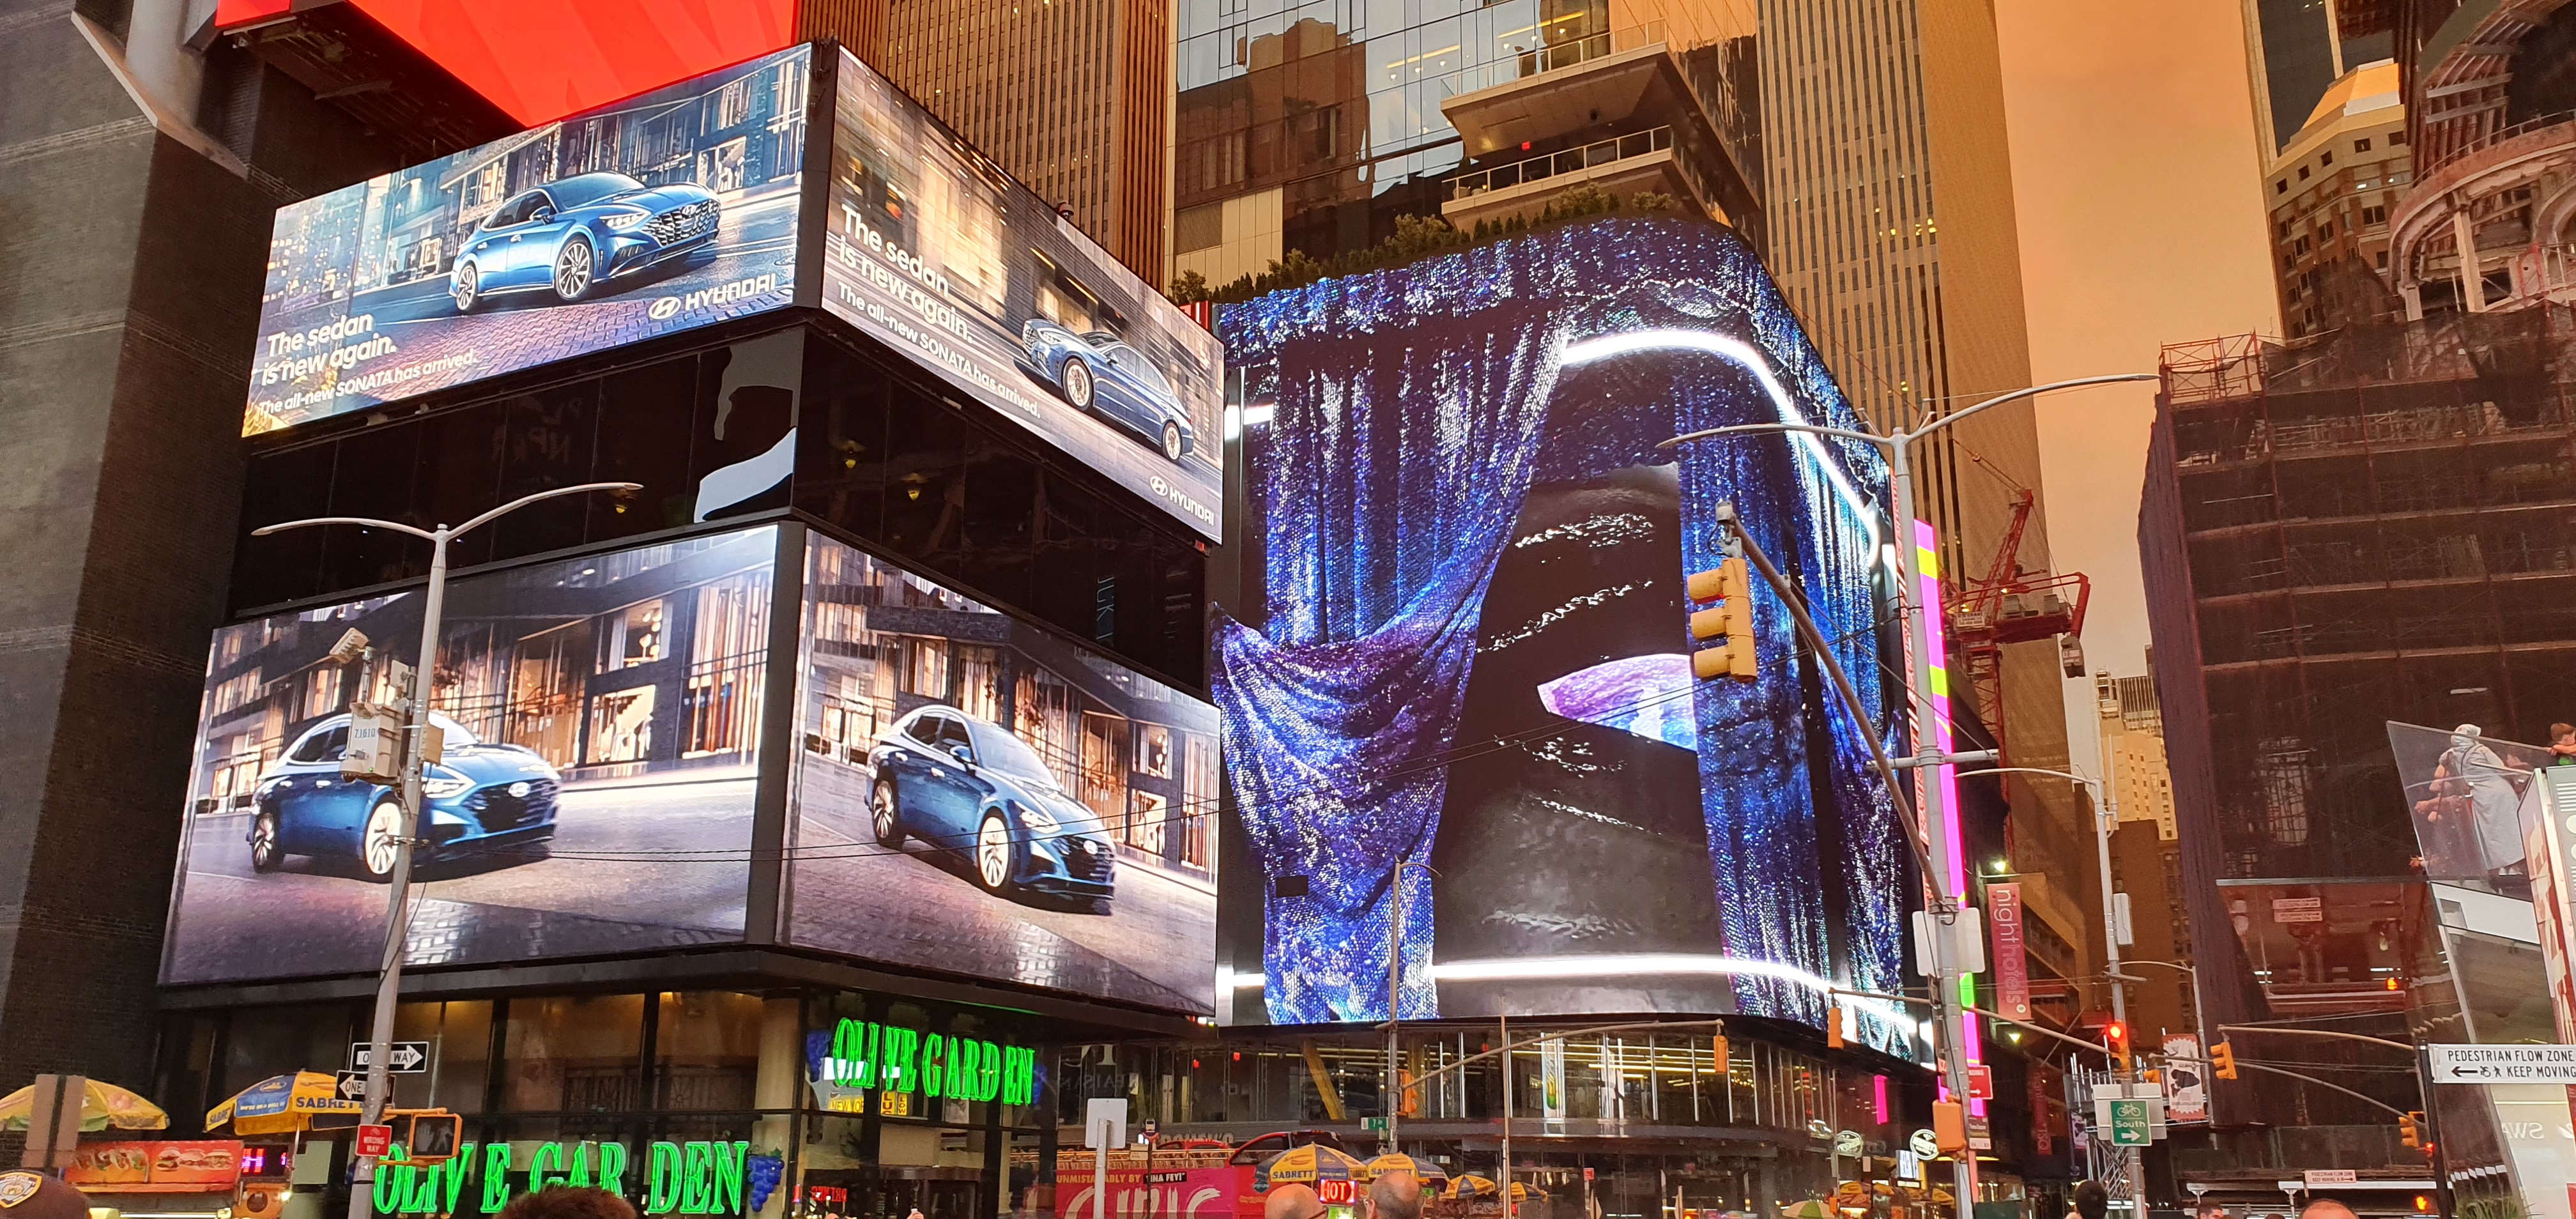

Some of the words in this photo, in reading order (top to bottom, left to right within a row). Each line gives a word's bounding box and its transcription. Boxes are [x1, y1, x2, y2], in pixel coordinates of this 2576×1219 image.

[841, 204, 882, 252] The
[885, 241, 950, 298] sedan
[685, 273, 776, 310] HYUNDAI
[839, 236, 857, 268] is
[861, 256, 907, 301] new
[910, 289, 974, 344] again.
[267, 331, 305, 358] The
[307, 314, 374, 347] sedan
[838, 281, 865, 311] The
[867, 299, 918, 342] all-new
[920, 333, 973, 378] SONATA
[974, 364, 996, 389] has
[998, 382, 1041, 419] arrived.
[261, 362, 279, 386] is
[280, 353, 327, 381] new
[330, 333, 397, 370] again.
[259, 401, 282, 415] The
[284, 387, 335, 410] all-new
[335, 372, 395, 397] SONATA
[395, 367, 420, 385] has
[422, 349, 479, 374] arrived.
[1170, 486, 1214, 526] HYUNDAI
[394, 1053, 415, 1062] WAY
[832, 1017, 917, 1093] OLIVE
[922, 1032, 1035, 1104] GARDEN
[2448, 1050, 2511, 1061] PEDESTRIAN
[2515, 1050, 2543, 1061] FLOW
[2547, 1050, 2575, 1061] ZONE
[2506, 1066, 2532, 1077] KEEP
[2536, 1066, 2576, 1077] MOVING
[345, 1081, 362, 1093] ONE
[832, 1101, 850, 1111] NEW
[2115, 1120, 2145, 1128] South
[372, 1142, 510, 1213] OLIVE
[1057, 1174, 1124, 1183] UNMISTAABLY
[1273, 1170, 1314, 1179] SABRETT
